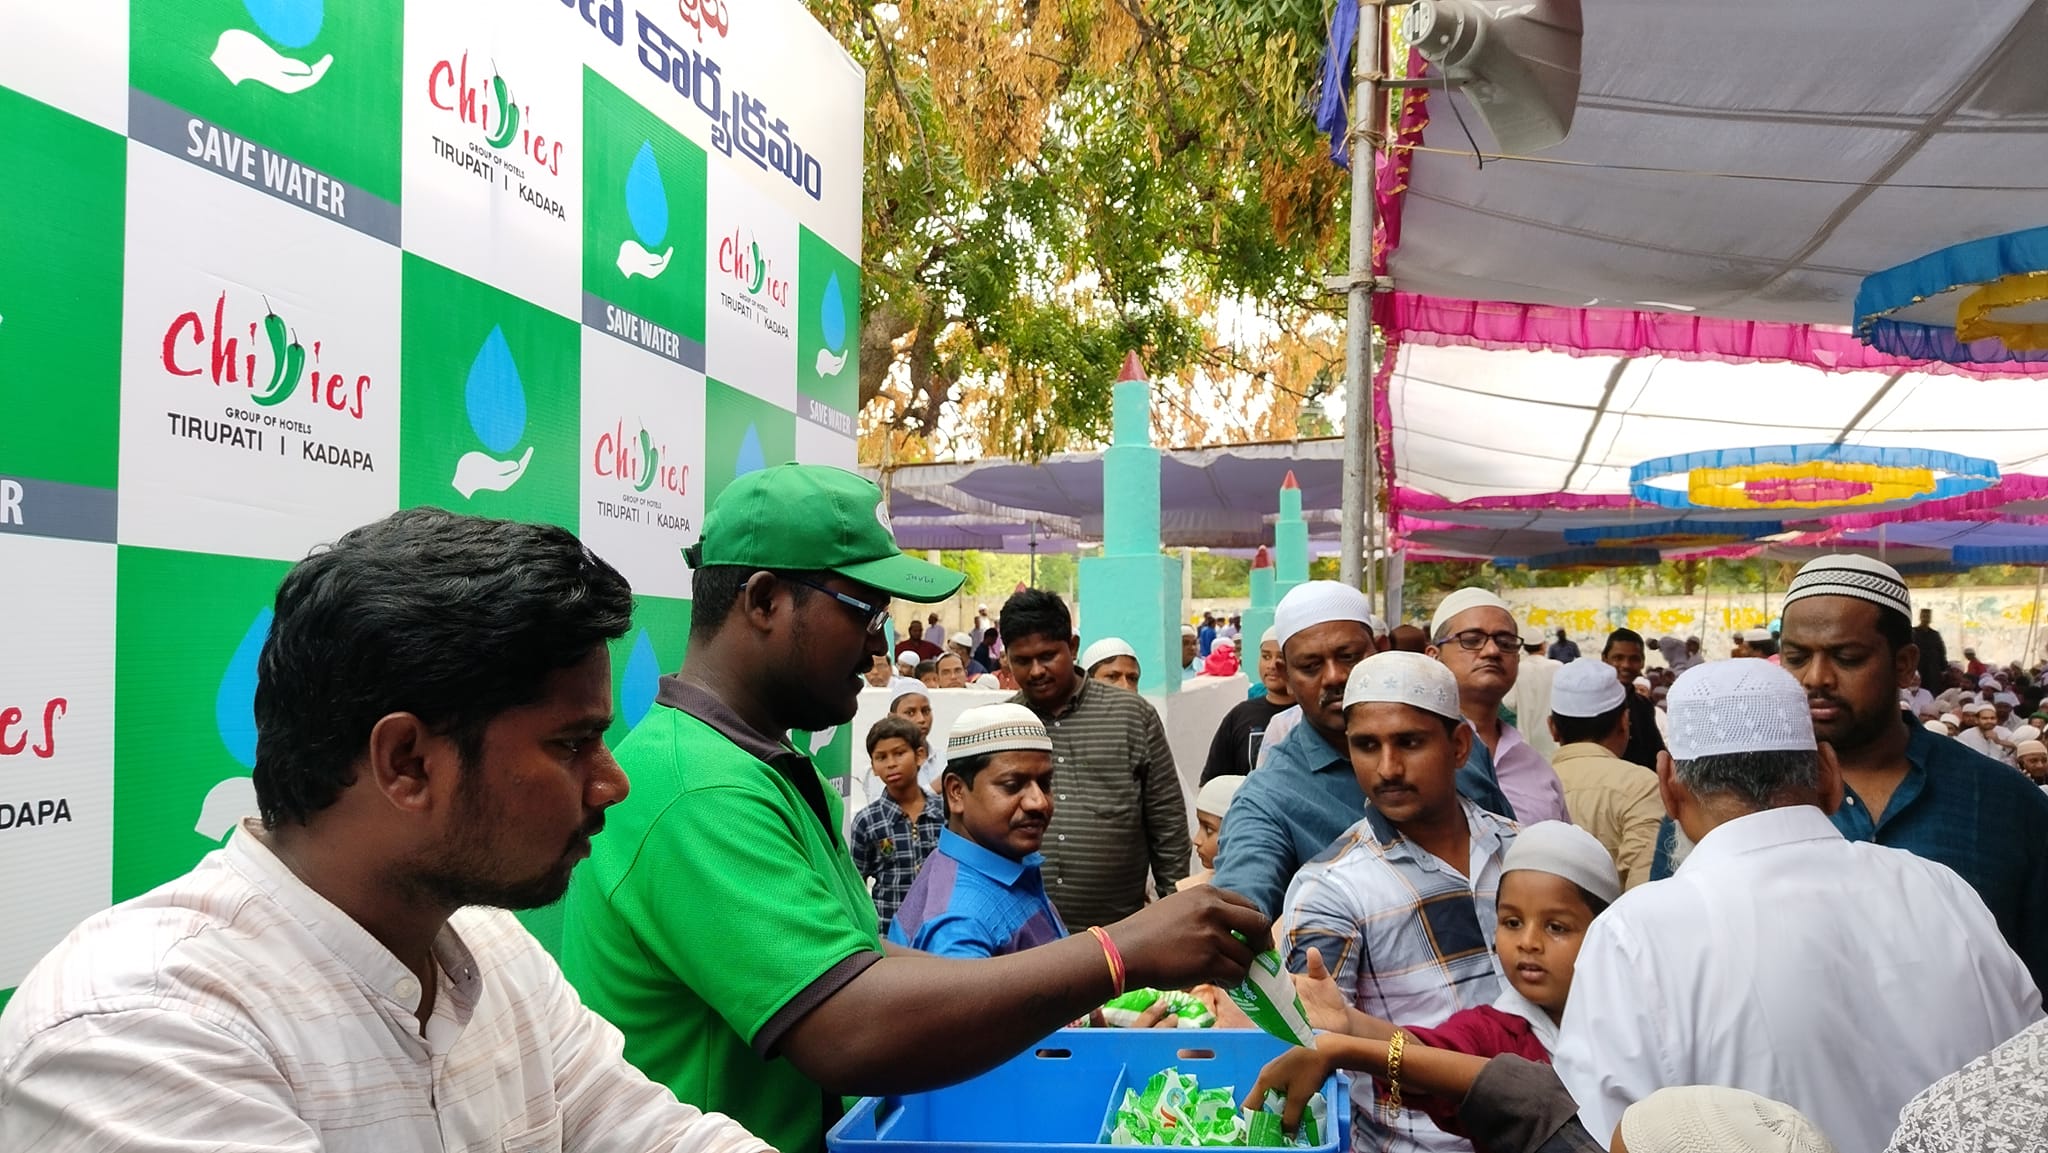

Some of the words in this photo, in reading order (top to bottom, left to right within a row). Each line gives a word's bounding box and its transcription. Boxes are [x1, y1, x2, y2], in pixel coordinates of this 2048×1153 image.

[636, 9, 822, 201] కార్యక్రమం
[186, 118, 257, 181] SAVE
[261, 149, 345, 218] WATER
[432, 135, 493, 183] TIRUPATI
[519, 183, 566, 222] KADAPA
[469, 142, 492, 160] GROUP
[493, 155, 502, 166] OF
[503, 161, 525, 179] HOTELS
[606, 304, 639, 342] SAVE
[639, 318, 680, 359] WATER
[721, 292, 752, 320] TIRUPATI
[764, 316, 790, 340] KADAPA
[225, 407, 261, 423] GROUP
[263, 415, 277, 427] OF
[279, 417, 312, 435] HOTELS
[810, 399, 828, 425] SAVE
[828, 407, 851, 434] WATER
[167, 412, 263, 452] TIRUPATI
[302, 440, 375, 472] KADAPA
[597, 500, 640, 523] TIRUPATI
[657, 513, 691, 532] KADAPA
[0, 798, 72, 830] DAPA
